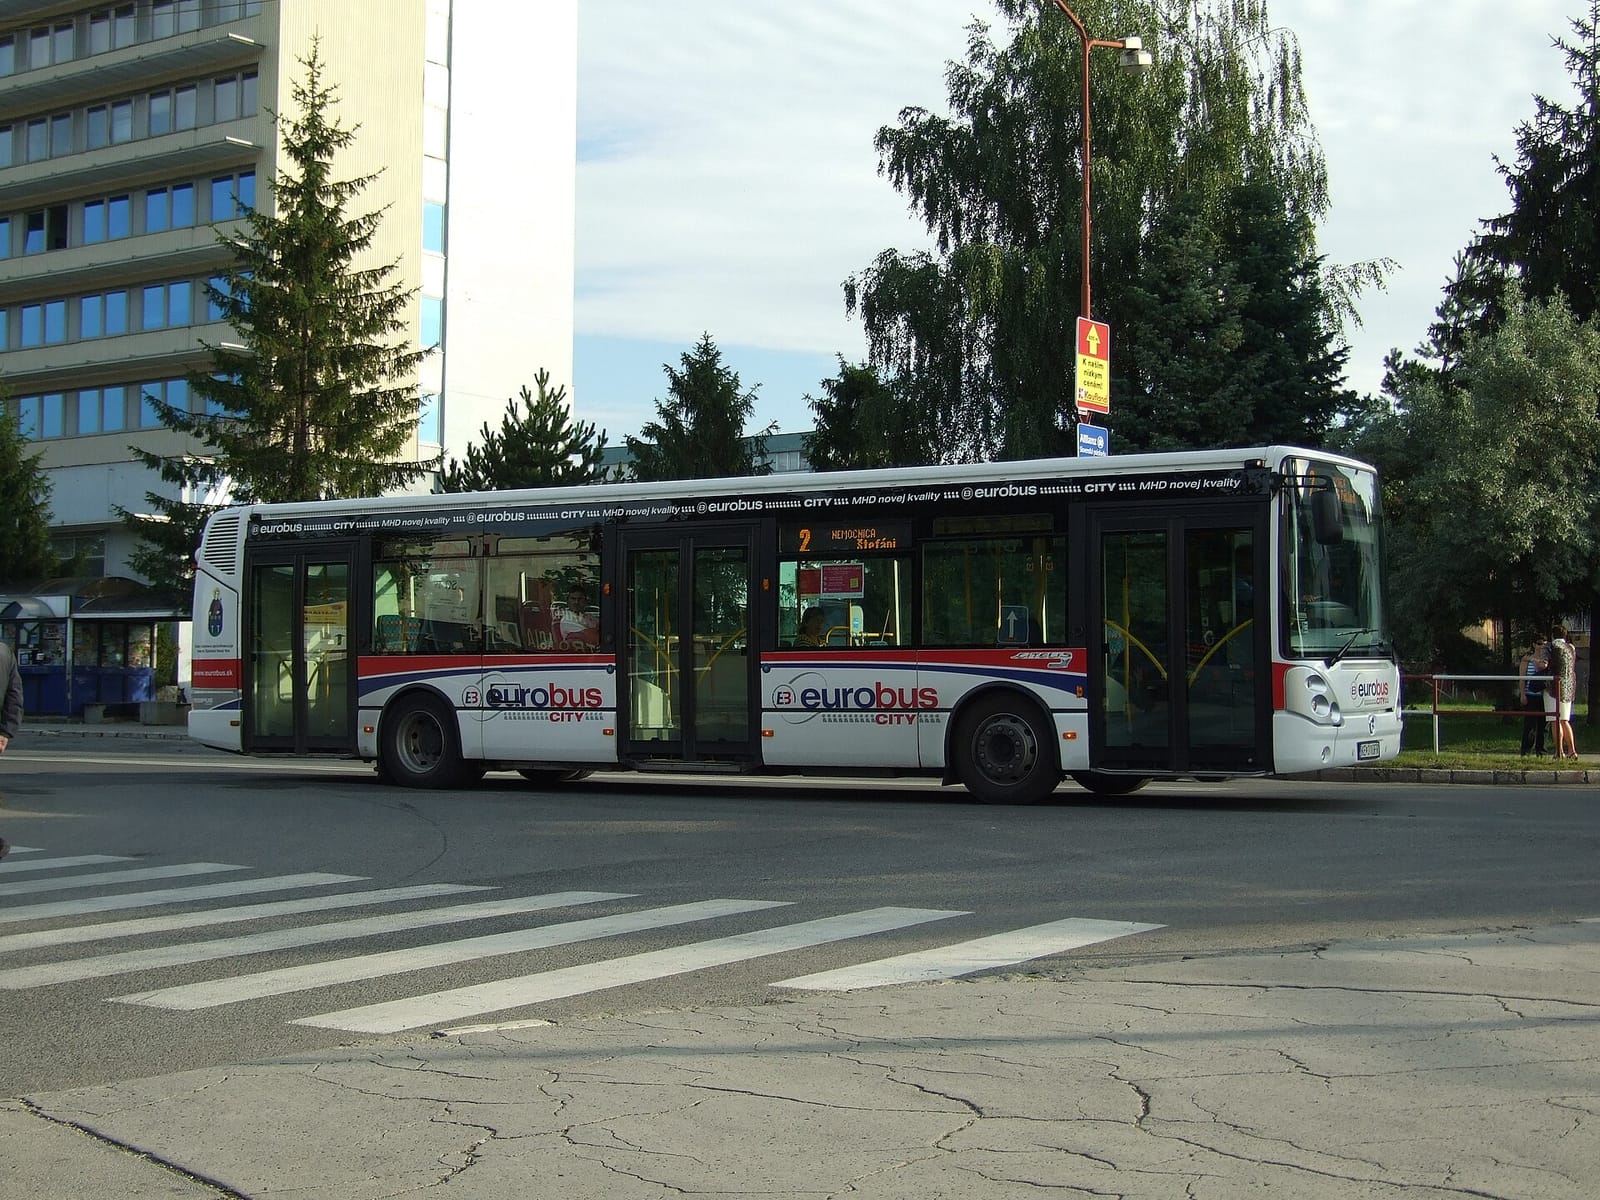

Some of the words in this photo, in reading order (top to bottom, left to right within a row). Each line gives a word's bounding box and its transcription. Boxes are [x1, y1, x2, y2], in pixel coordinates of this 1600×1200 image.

[260, 522, 303, 534] eurobus
[333, 522, 355, 530] CITY
[382, 519, 401, 528] MHD
[402, 518, 424, 527] novej
[424, 516, 451, 526] kvality
[476, 510, 525, 523] eurobus
[560, 510, 587, 519] CITY
[602, 508, 625, 517] MHD
[625, 507, 650, 517] novej
[651, 505, 680, 515] kvality
[708, 500, 763, 513] eurobus
[804, 498, 832, 508] CITY
[852, 495, 877, 505] MHD
[878, 493, 907, 504] novej
[907, 491, 941, 502] kvality
[974, 484, 1037, 498] eurobus
[1084, 482, 1117, 493] CITY
[1139, 480, 1167, 491] MHD
[1169, 479, 1201, 490] novej
[1203, 478, 1241, 489] kvality
[800, 529, 811, 552] 2
[832, 528, 876, 540] NEMOCNICA
[486, 682, 603, 708] eurobus
[801, 682, 939, 709] eurobus
[1358, 678, 1389, 697] eurobus
[550, 712, 585, 723] CITY
[875, 713, 917, 725] CITY
